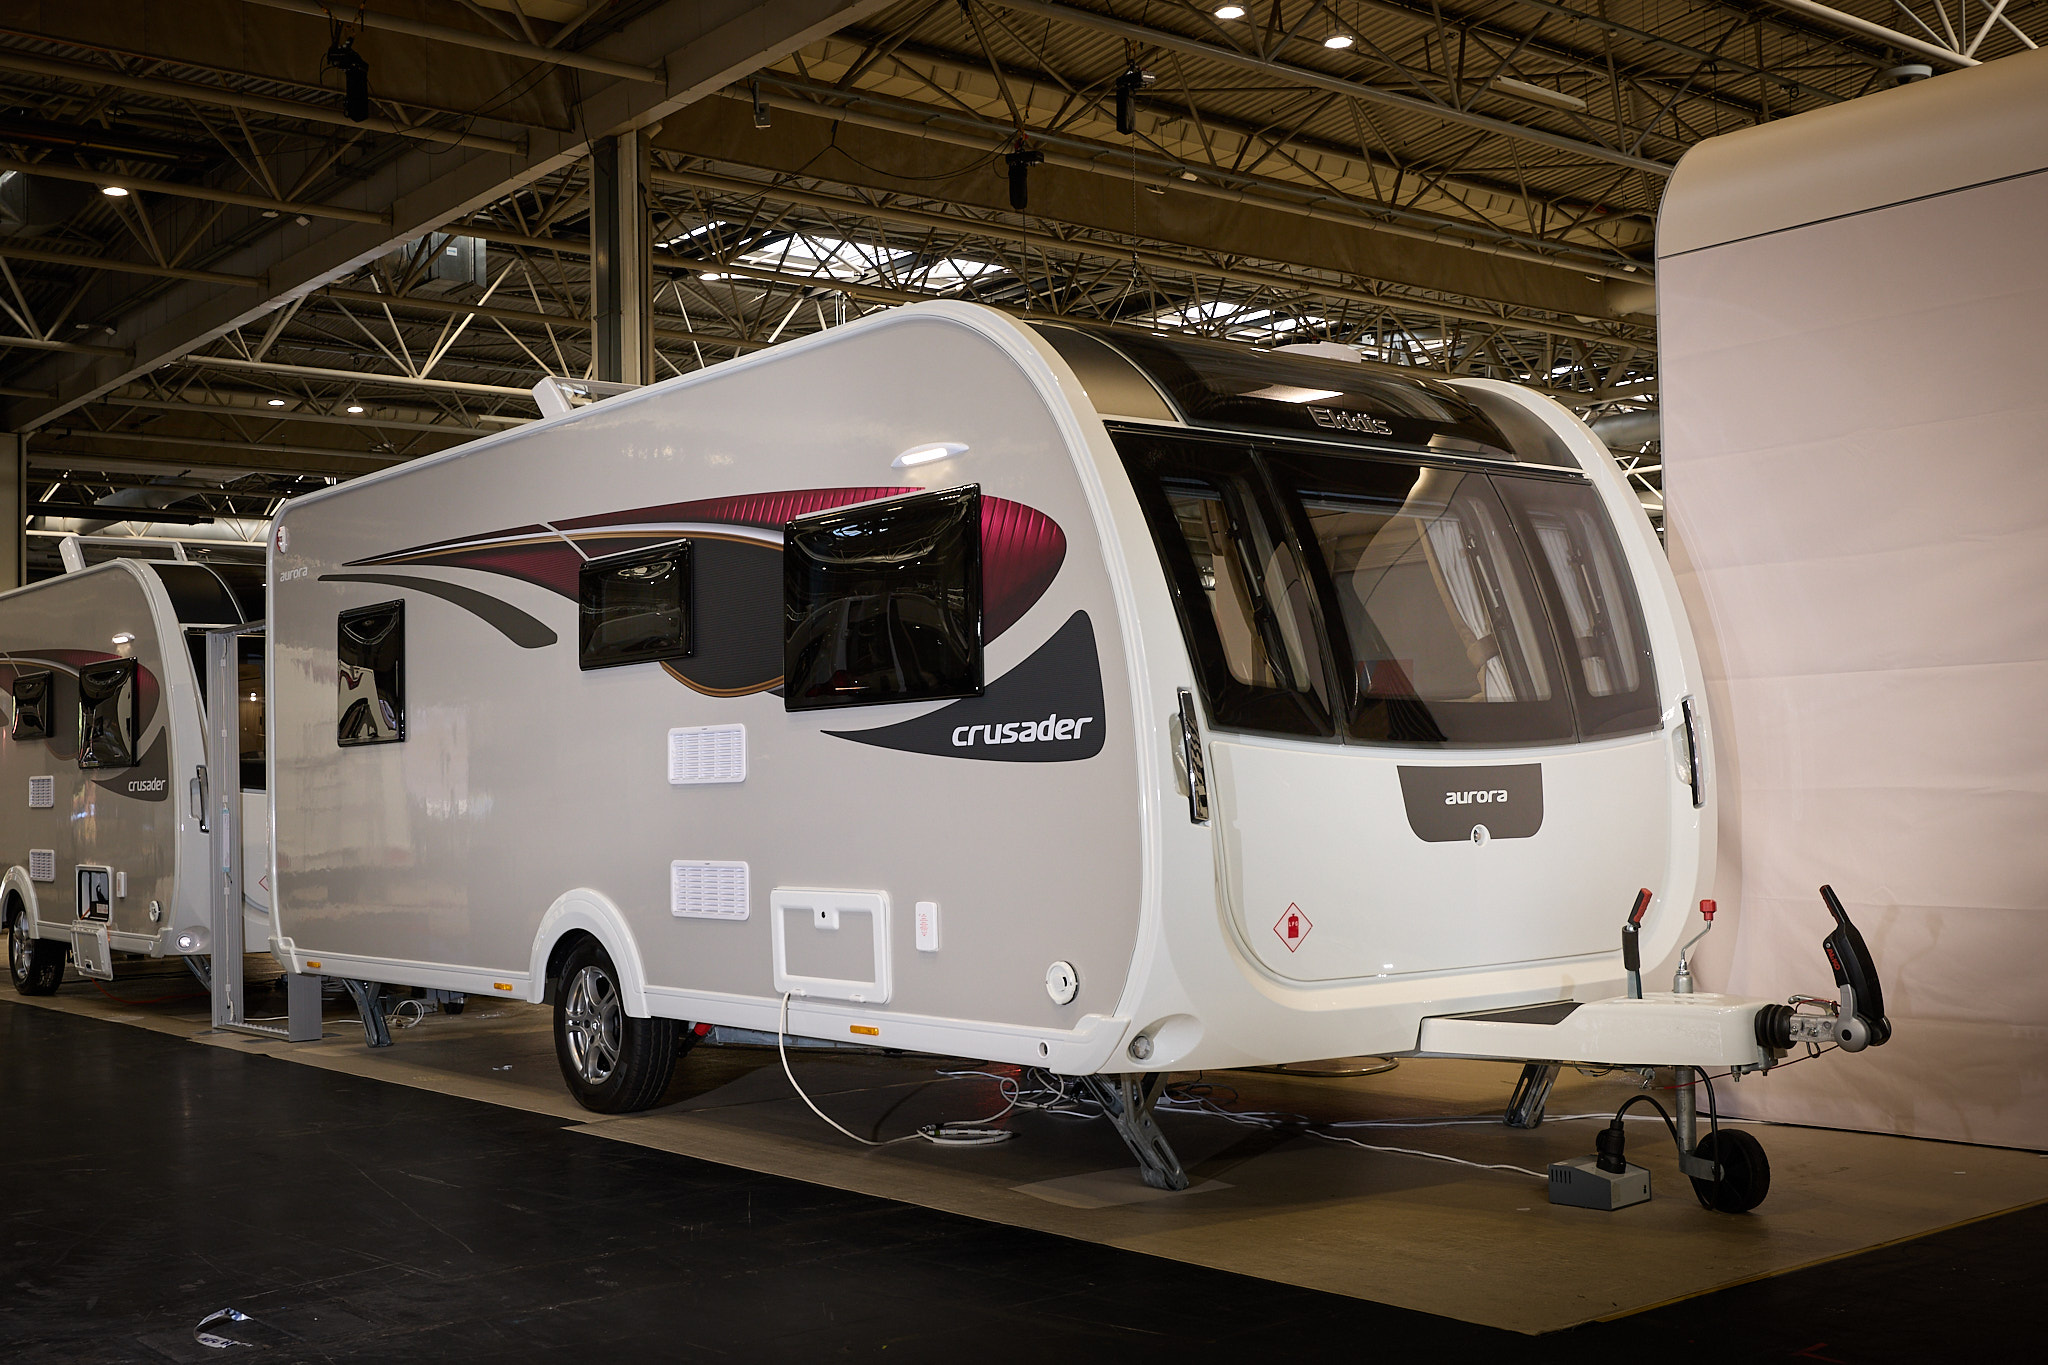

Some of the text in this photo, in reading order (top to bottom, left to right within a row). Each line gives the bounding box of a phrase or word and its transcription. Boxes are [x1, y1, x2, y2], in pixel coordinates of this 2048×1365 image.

[1307, 406, 1393, 436] Elddis
[280, 566, 308, 582] aurora
[952, 713, 1094, 747] crusader
[128, 777, 166, 792] crusader
[1445, 789, 1508, 805] aurora
